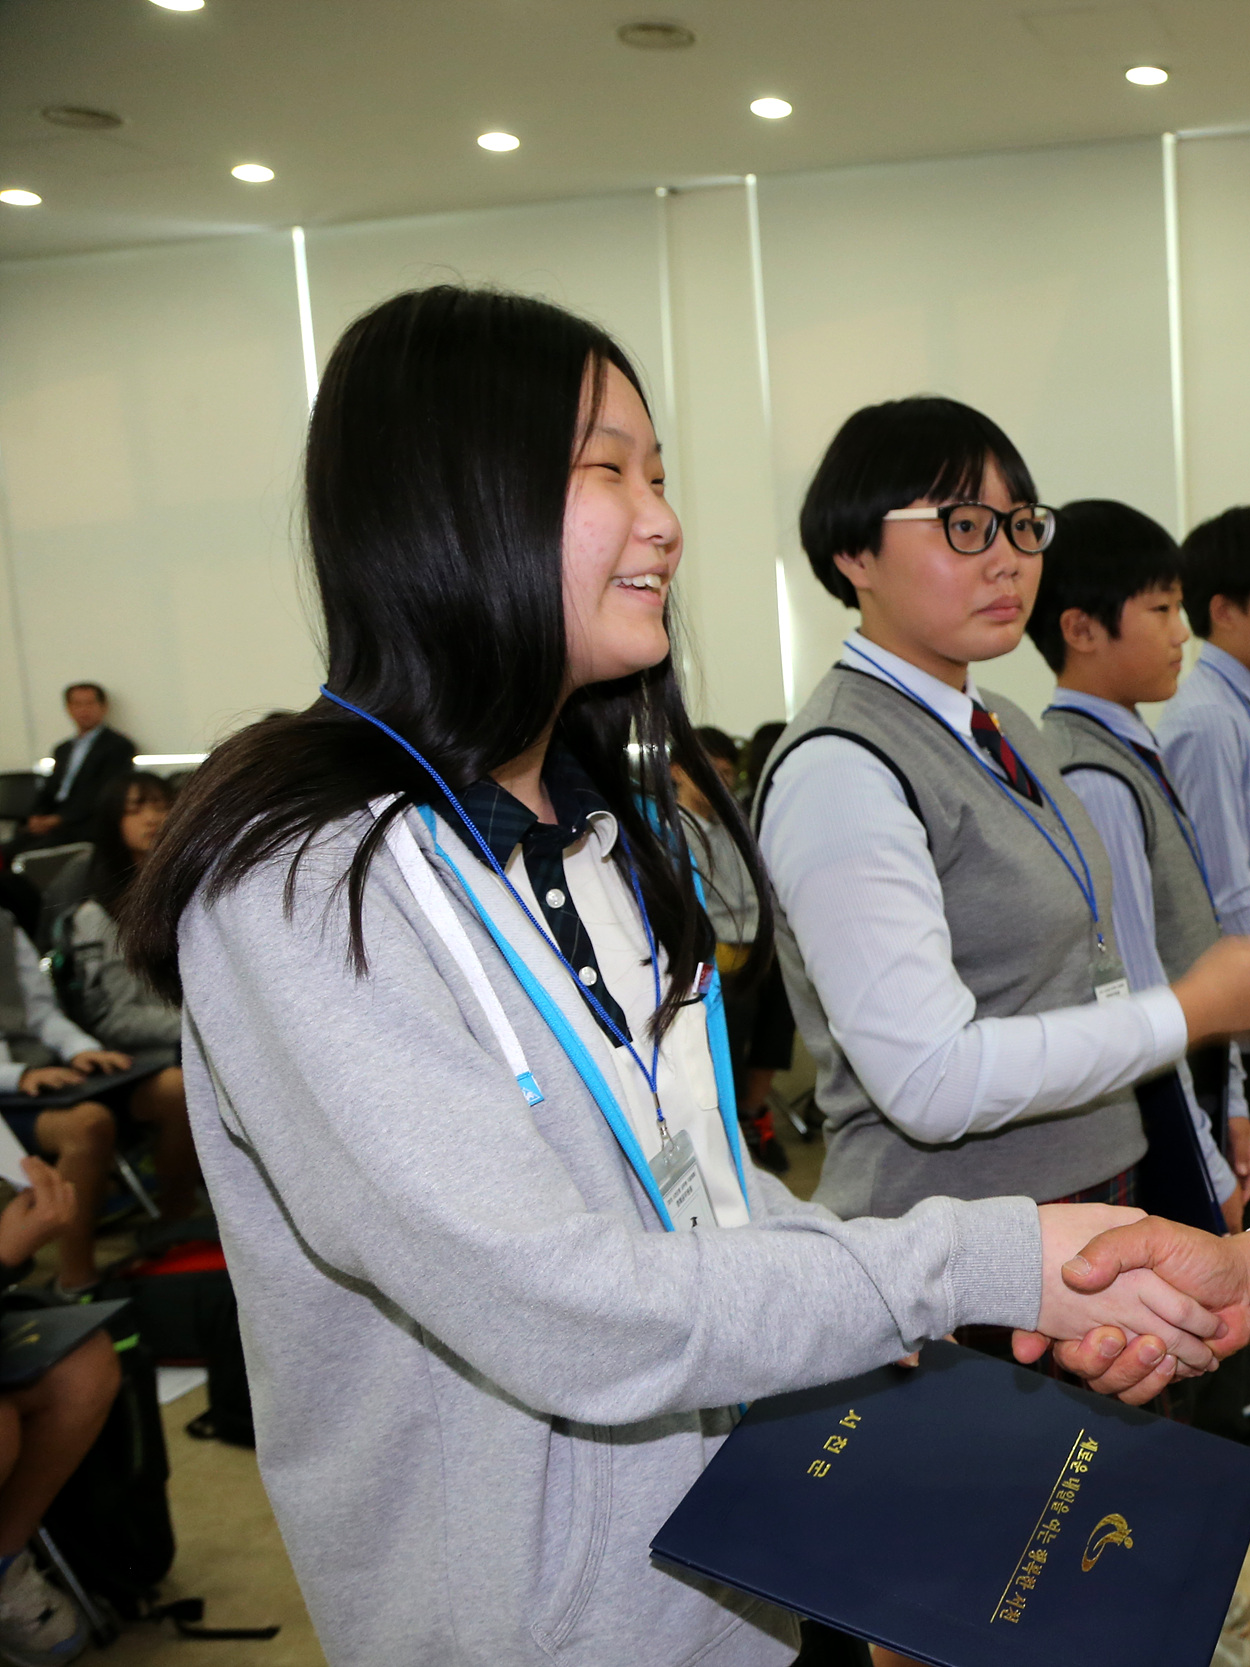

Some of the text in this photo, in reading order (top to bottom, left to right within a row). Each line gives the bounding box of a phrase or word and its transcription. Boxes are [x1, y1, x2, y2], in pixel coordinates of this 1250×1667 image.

[1000, 1437, 1098, 1623] 새로운 내일을 여는 행복한 서천
